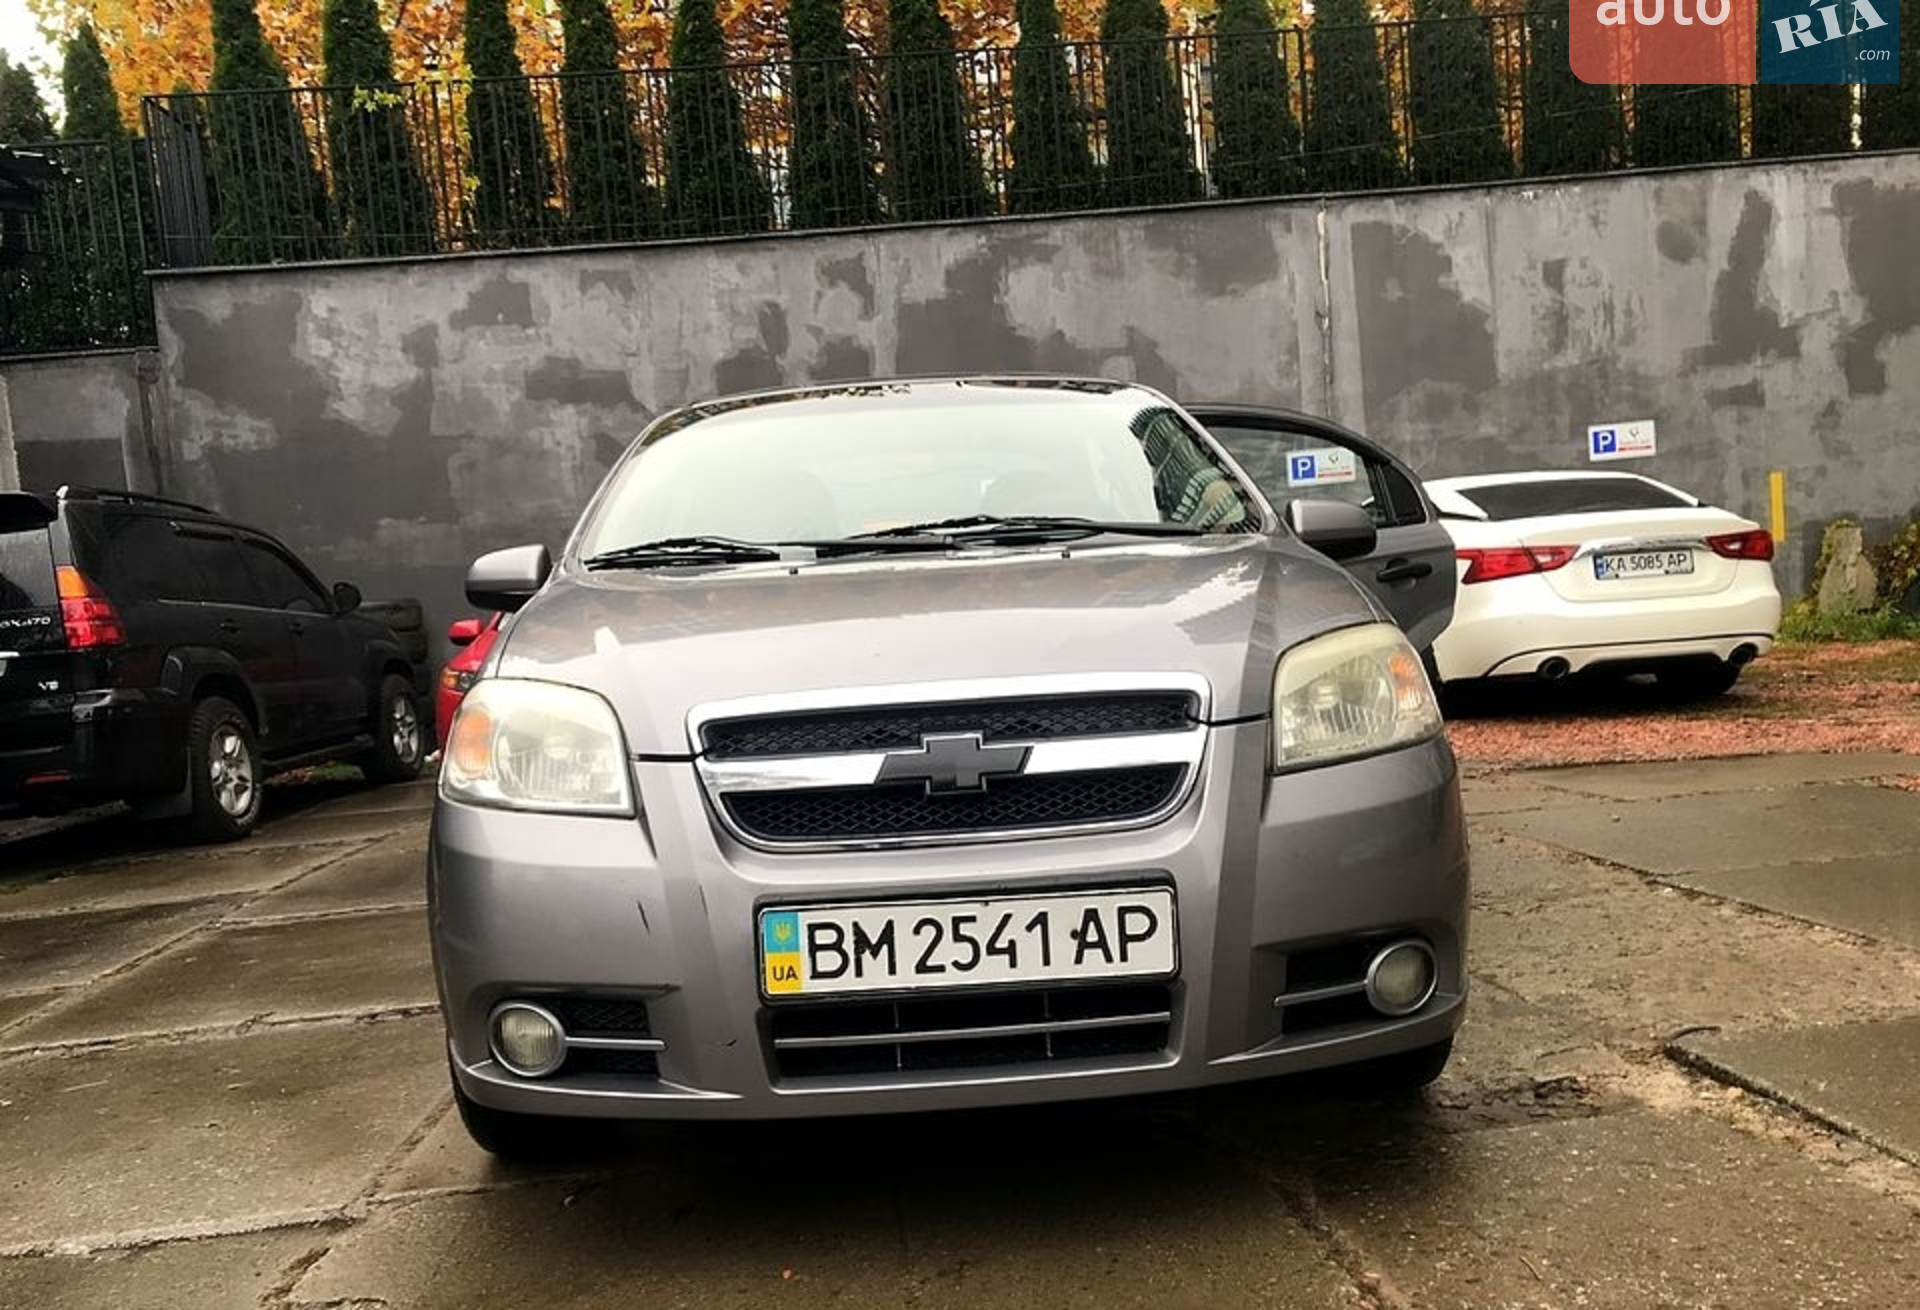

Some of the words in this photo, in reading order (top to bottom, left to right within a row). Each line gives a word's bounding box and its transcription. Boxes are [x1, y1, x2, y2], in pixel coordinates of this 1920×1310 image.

[1599, 432, 1613, 452] P
[1297, 458, 1312, 479] P
[1605, 557, 1627, 572] KA
[1630, 554, 1664, 571] 5085
[1667, 552, 1687, 568] AP
[807, 918, 897, 980] BM
[912, 911, 1051, 975] 2541
[1074, 904, 1158, 965] AP
[772, 966, 799, 982] UA
